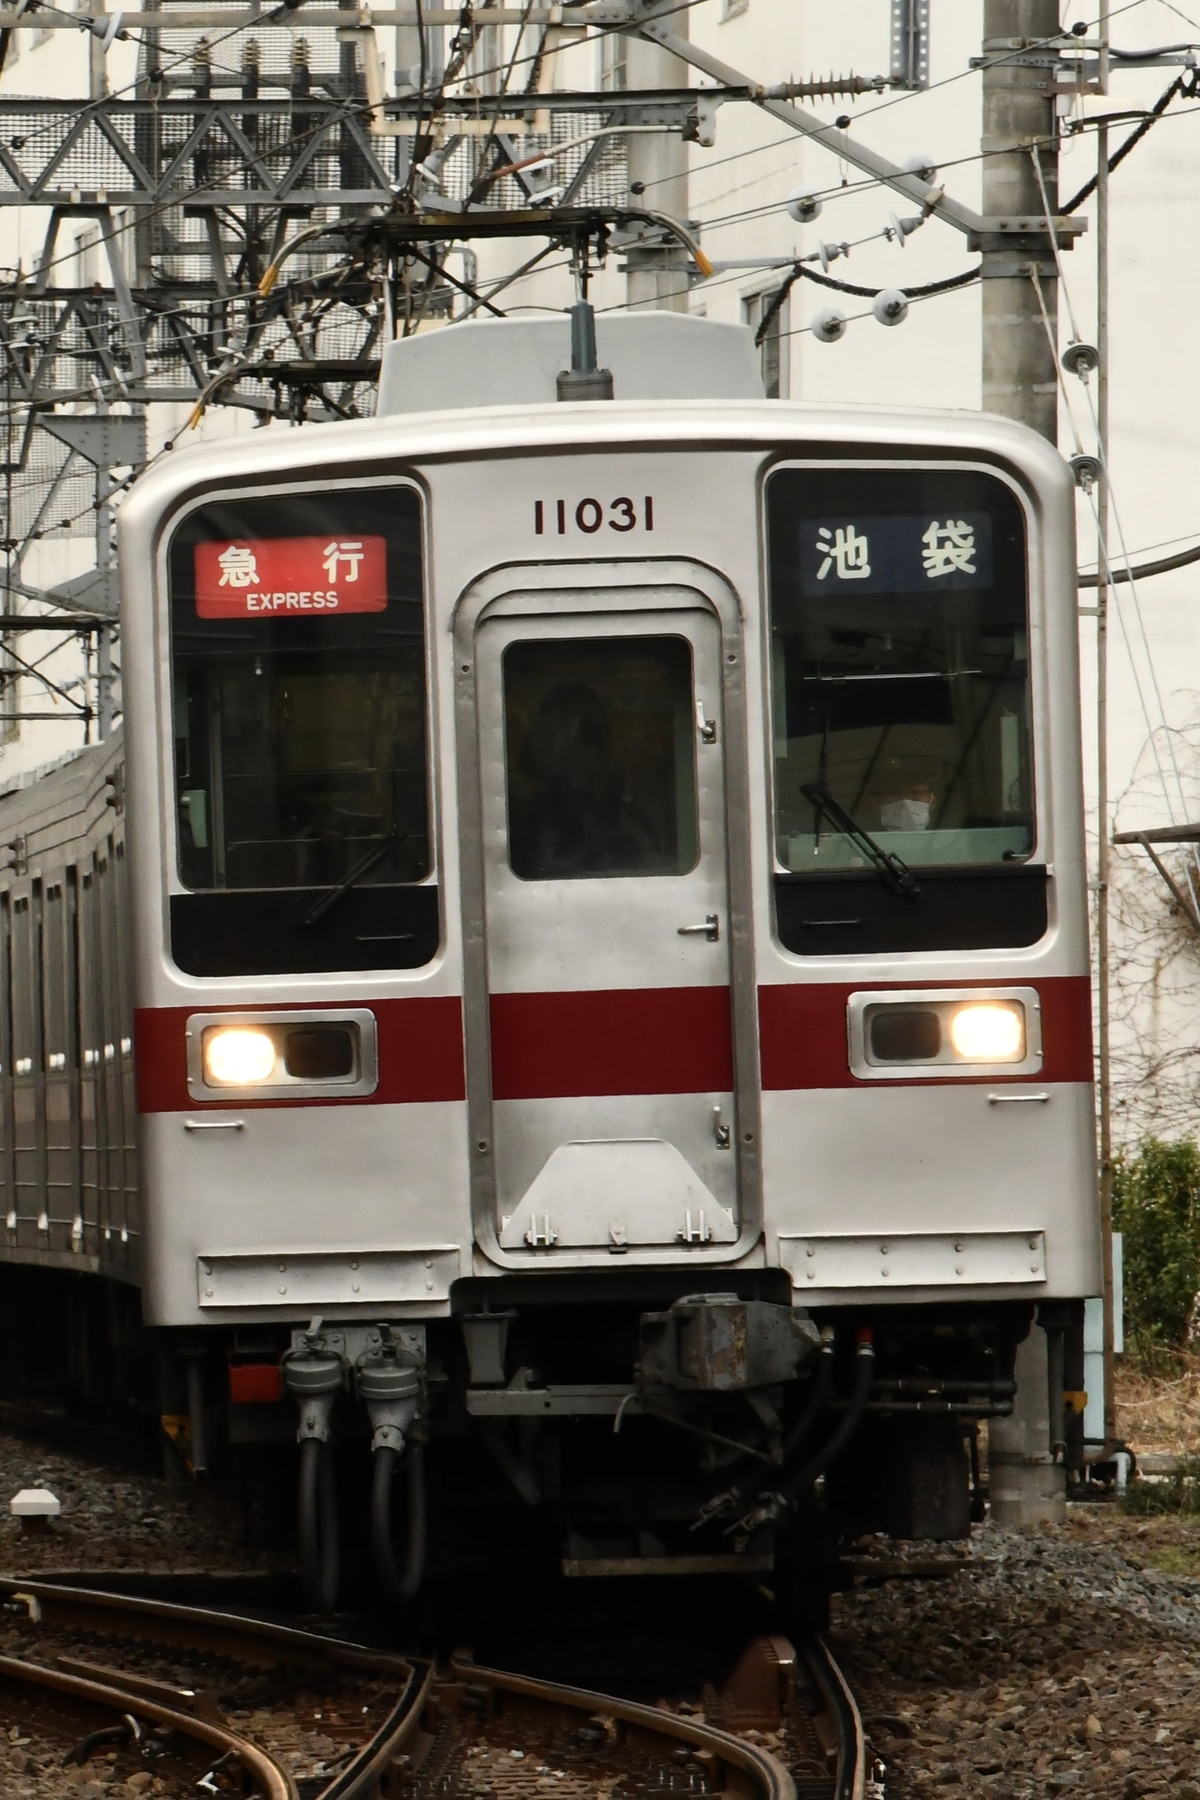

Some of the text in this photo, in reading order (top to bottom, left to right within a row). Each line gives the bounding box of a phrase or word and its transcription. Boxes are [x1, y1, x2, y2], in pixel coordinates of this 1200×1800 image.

[535, 496, 653, 534] 11031
[218, 542, 364, 587] 急行
[816, 520, 976, 580] 池袋
[247, 591, 338, 610] EXPRESS
